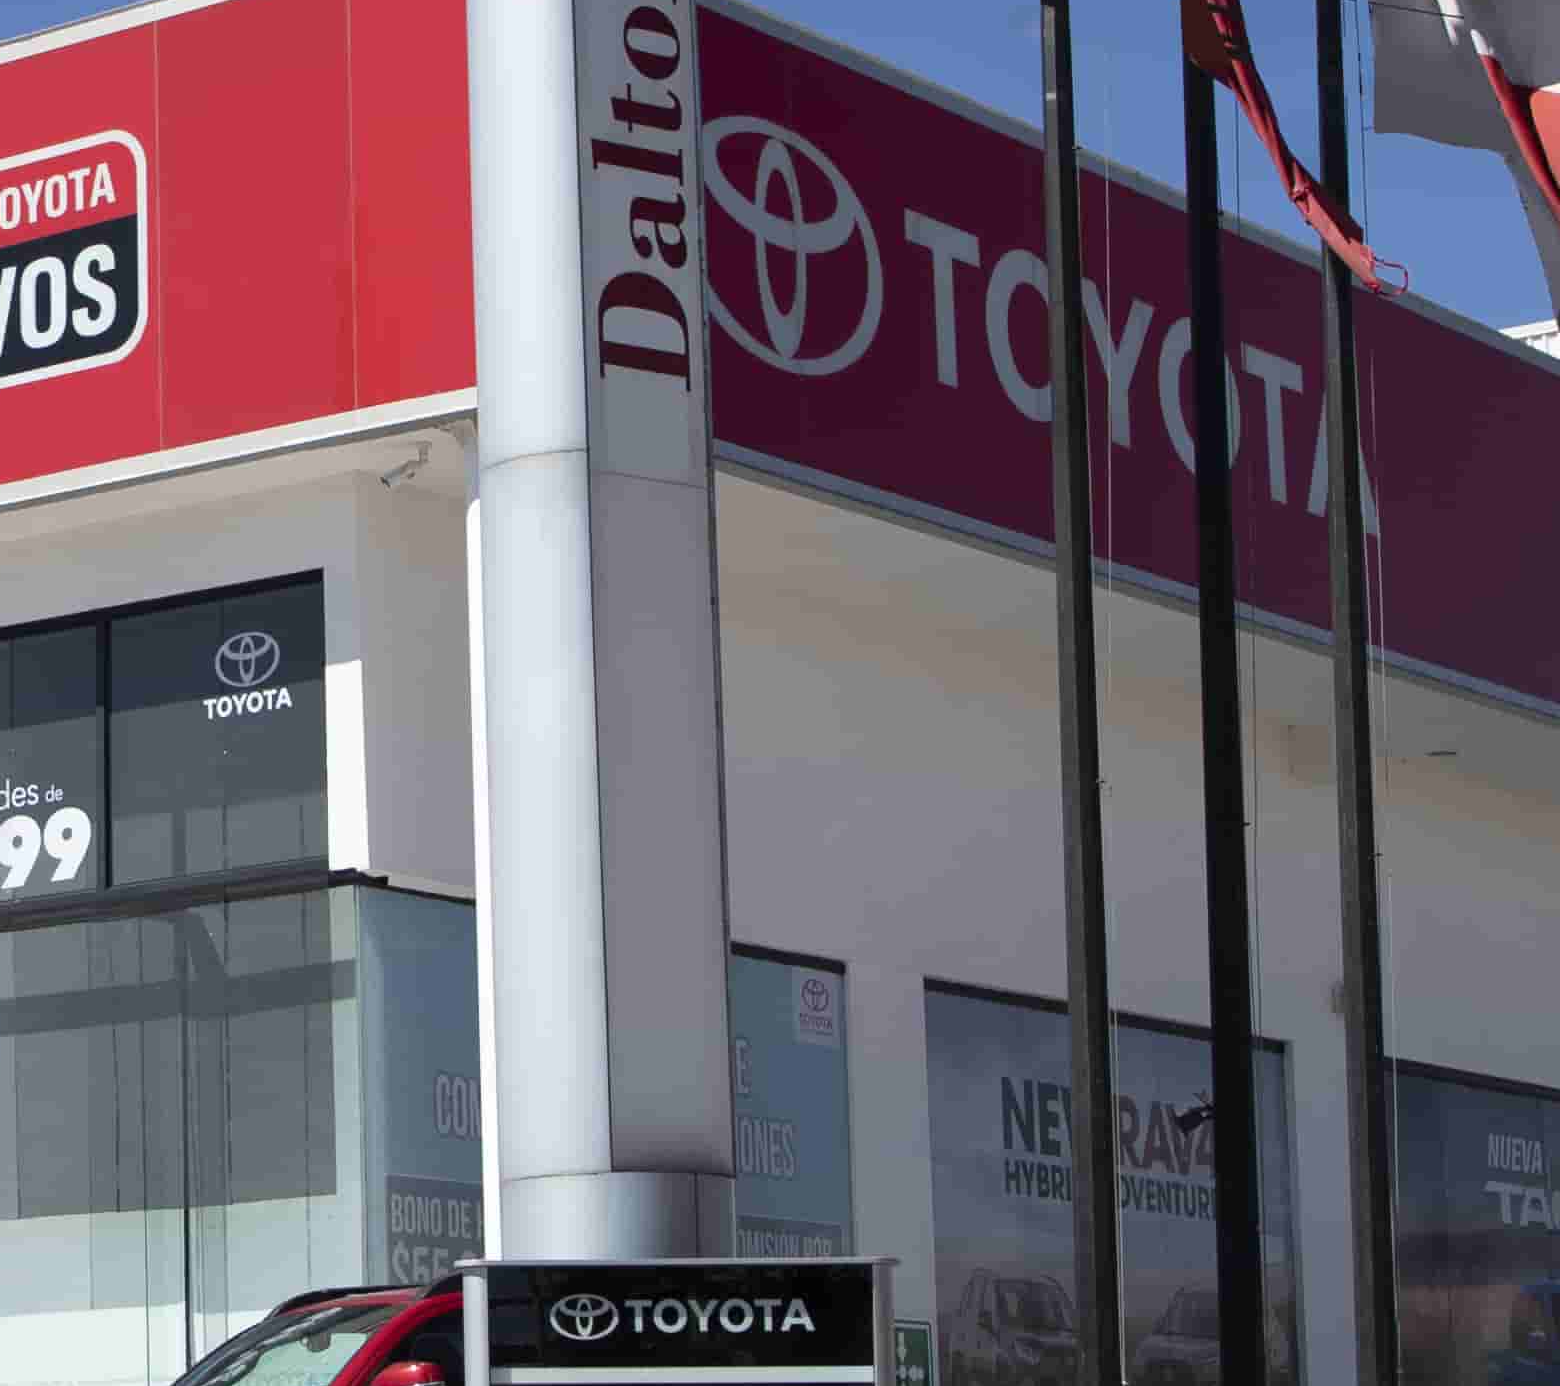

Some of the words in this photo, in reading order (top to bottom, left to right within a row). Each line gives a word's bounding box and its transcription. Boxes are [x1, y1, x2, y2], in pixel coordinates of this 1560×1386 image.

[203, 687, 293, 720] TOYOTA
[44, 783, 64, 804] de
[1487, 1132, 1544, 1174] NUEVA
[624, 1298, 816, 1334] TOYOTA
